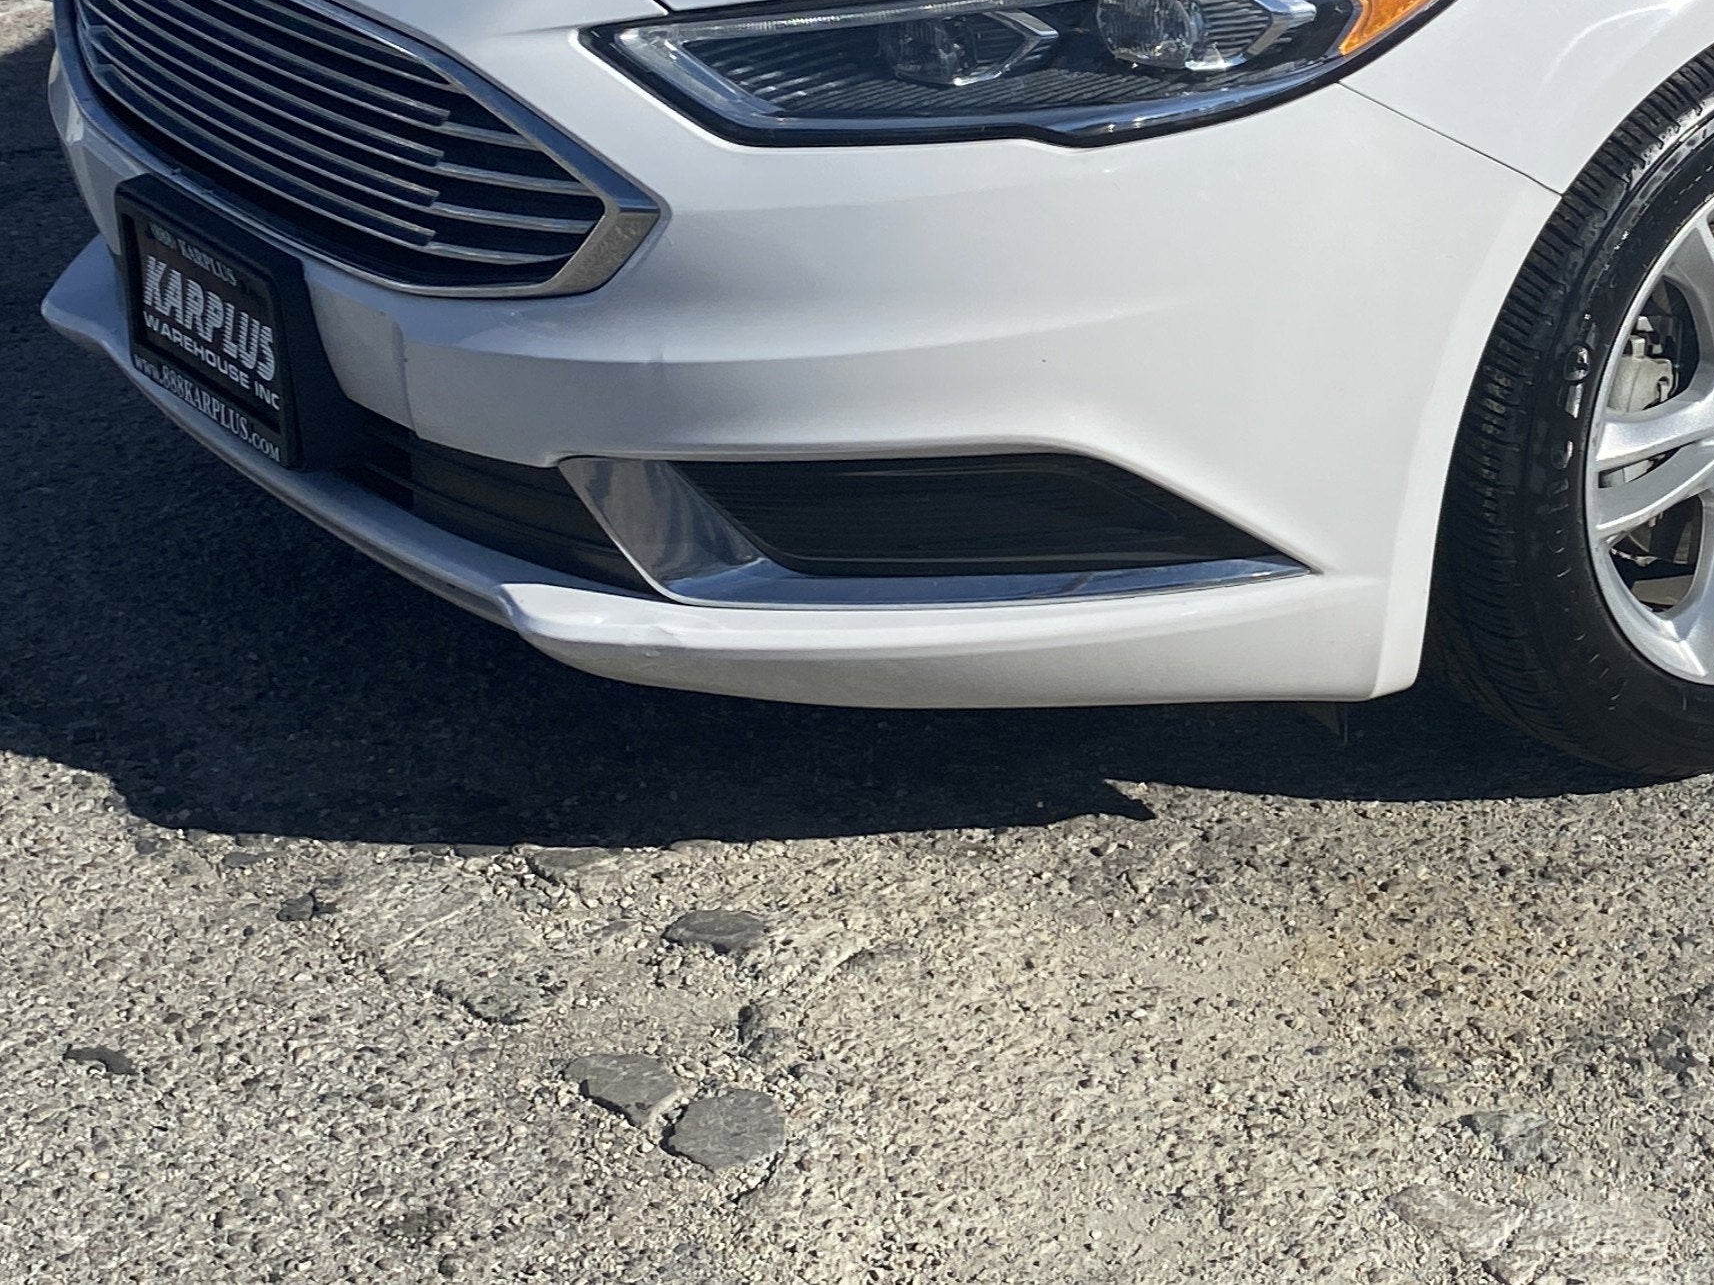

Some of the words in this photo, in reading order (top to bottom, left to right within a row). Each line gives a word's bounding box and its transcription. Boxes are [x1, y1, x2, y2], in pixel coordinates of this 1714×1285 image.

[177, 238, 237, 287] KARPLUS
[143, 255, 275, 381] KARPLUS
[143, 310, 251, 389] WAREHOUSE
[254, 380, 281, 411] INC
